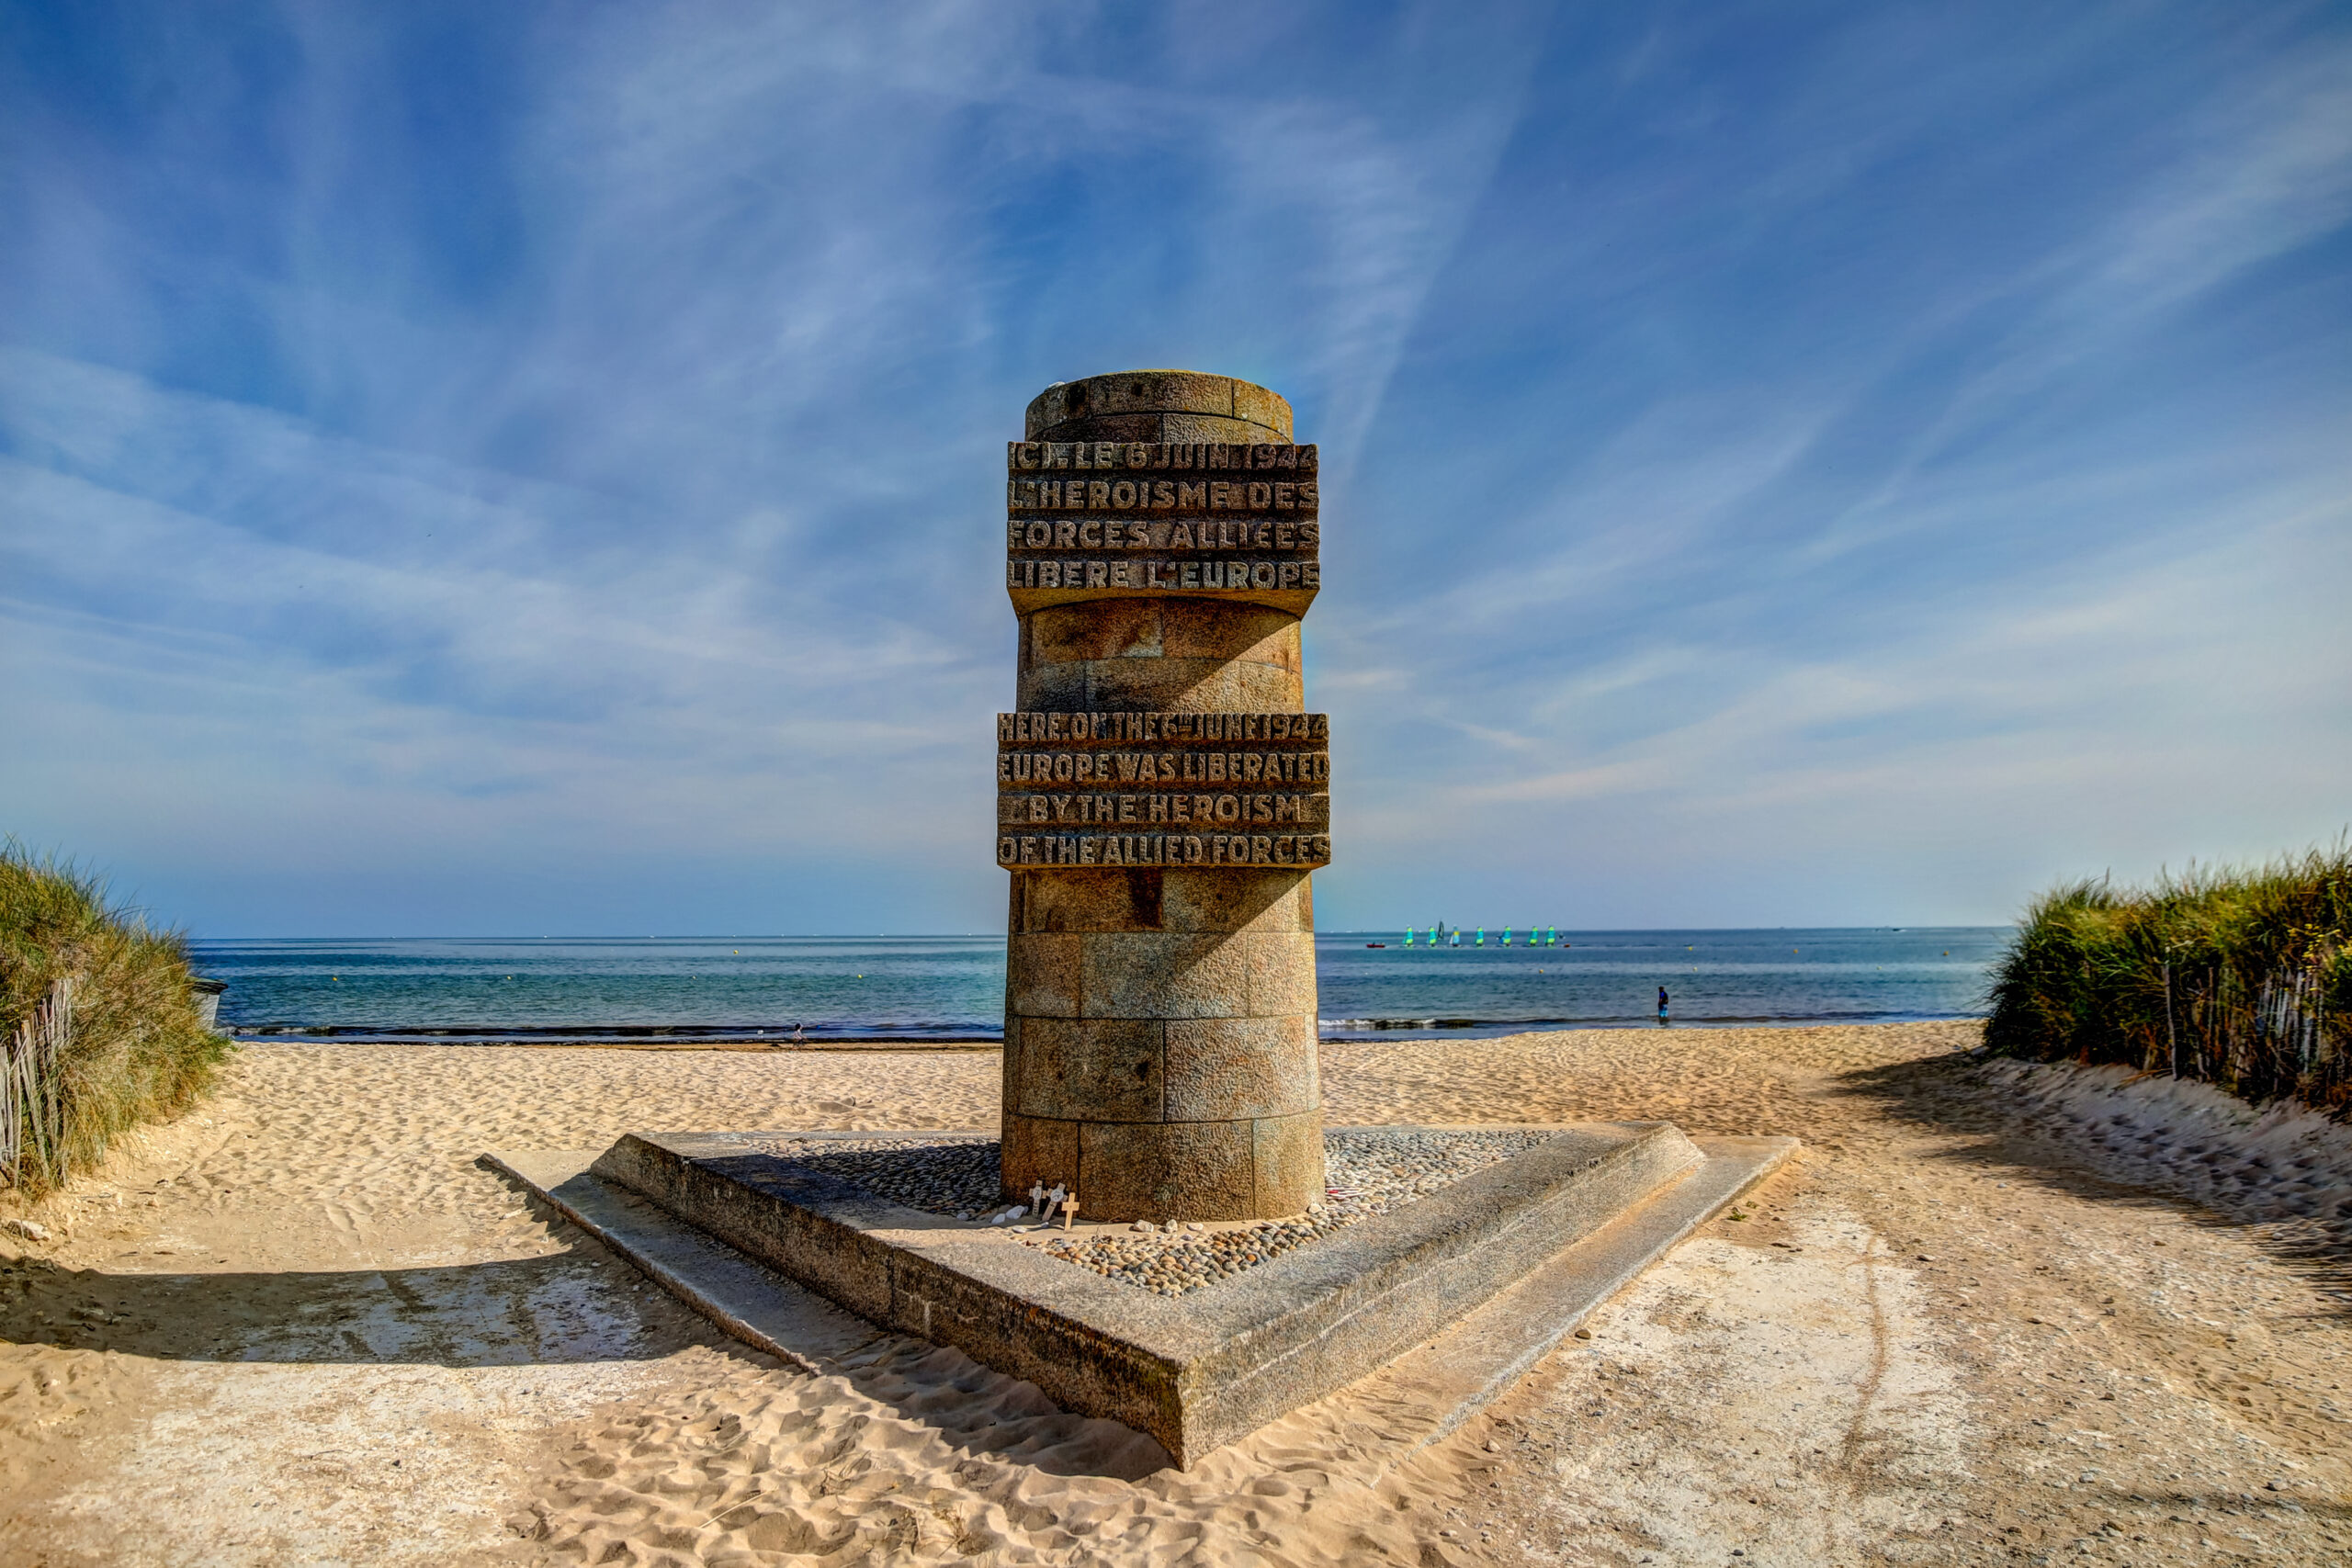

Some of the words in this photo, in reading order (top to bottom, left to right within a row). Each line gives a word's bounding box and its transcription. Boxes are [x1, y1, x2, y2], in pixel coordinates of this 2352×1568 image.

[1075, 441, 1113, 469] LE
[1125, 442, 1148, 468] 6
[1153, 442, 1228, 470] JUIN
[1242, 444, 1318, 470] 1944
[1008, 480, 1229, 509] L'HEROISME
[1249, 482, 1319, 509] DES
[1008, 521, 1149, 548] FORCES
[1169, 522, 1319, 549] ALLIEES
[1007, 561, 1129, 589] LIBERE
[1148, 561, 1320, 590] L'EUROPE
[1114, 713, 1158, 741] THE
[1195, 714, 1256, 740] JUNE
[1262, 714, 1329, 741] 1944
[998, 753, 1110, 782] EUROPE
[1115, 753, 1176, 782] WAS
[1183, 753, 1329, 782] LIBERATED
[1028, 795, 1071, 822] BY
[1077, 795, 1136, 822] THE
[1149, 795, 1300, 822] HEROISM
[999, 836, 1036, 864] OF
[1044, 836, 1095, 864] THE
[1102, 836, 1203, 864] ALLIED
[1213, 835, 1329, 863] FORCES
